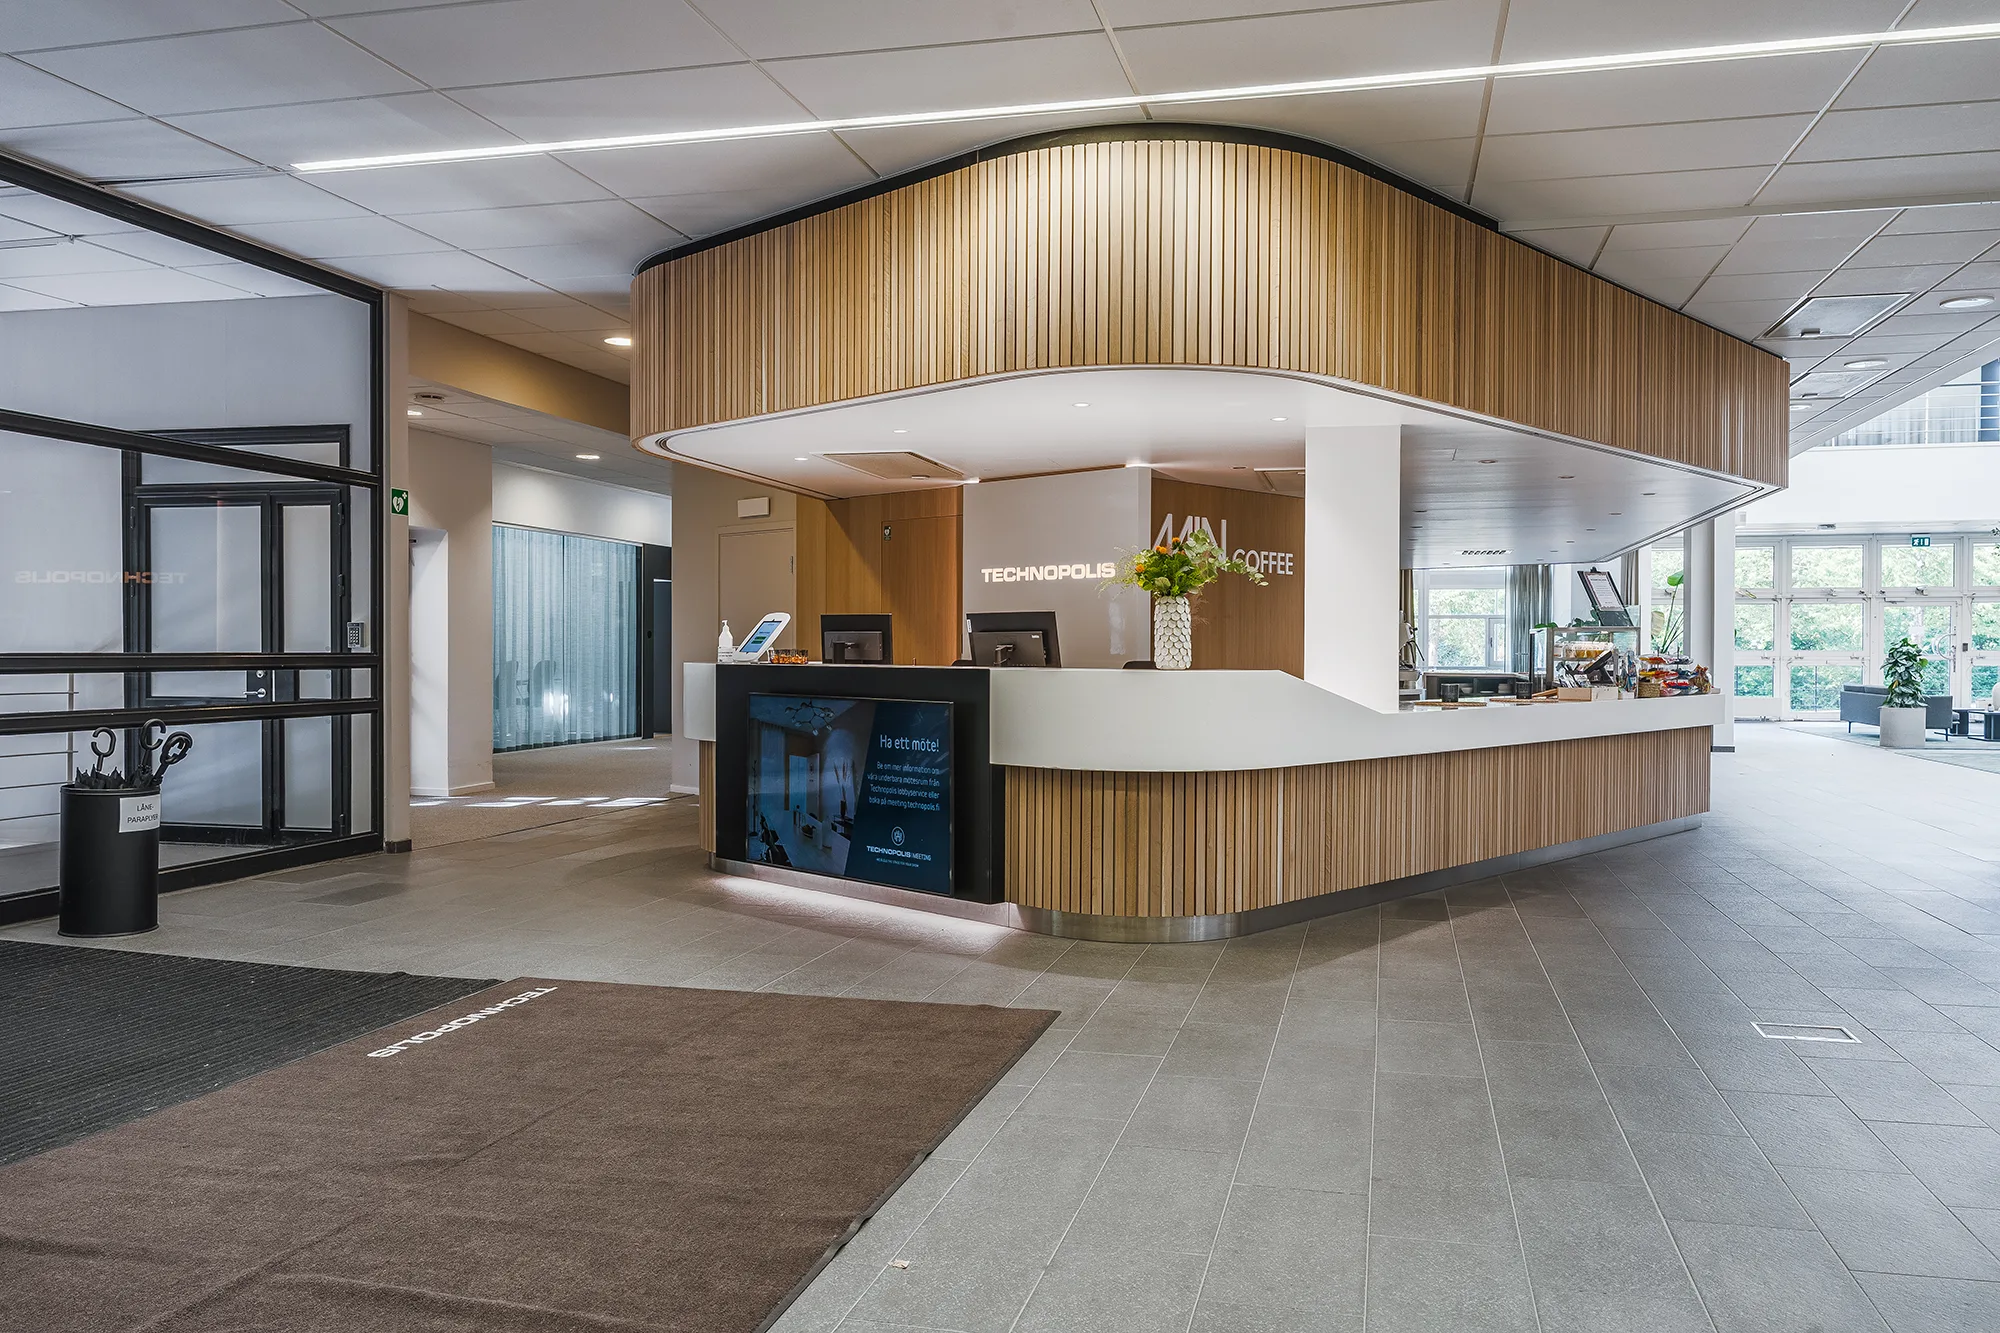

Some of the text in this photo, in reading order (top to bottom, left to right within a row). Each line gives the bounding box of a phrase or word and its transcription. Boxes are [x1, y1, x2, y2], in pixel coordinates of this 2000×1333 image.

[1232, 548, 1294, 575] COFFEE
[981, 562, 1116, 583] TECHNOPOLIS
[880, 734, 940, 752] Ha ett möte!
[870, 784, 897, 795] Technopolis
[866, 845, 911, 858] TECHNOPOLIS
[367, 986, 558, 1058] TECHNOPOLIS
